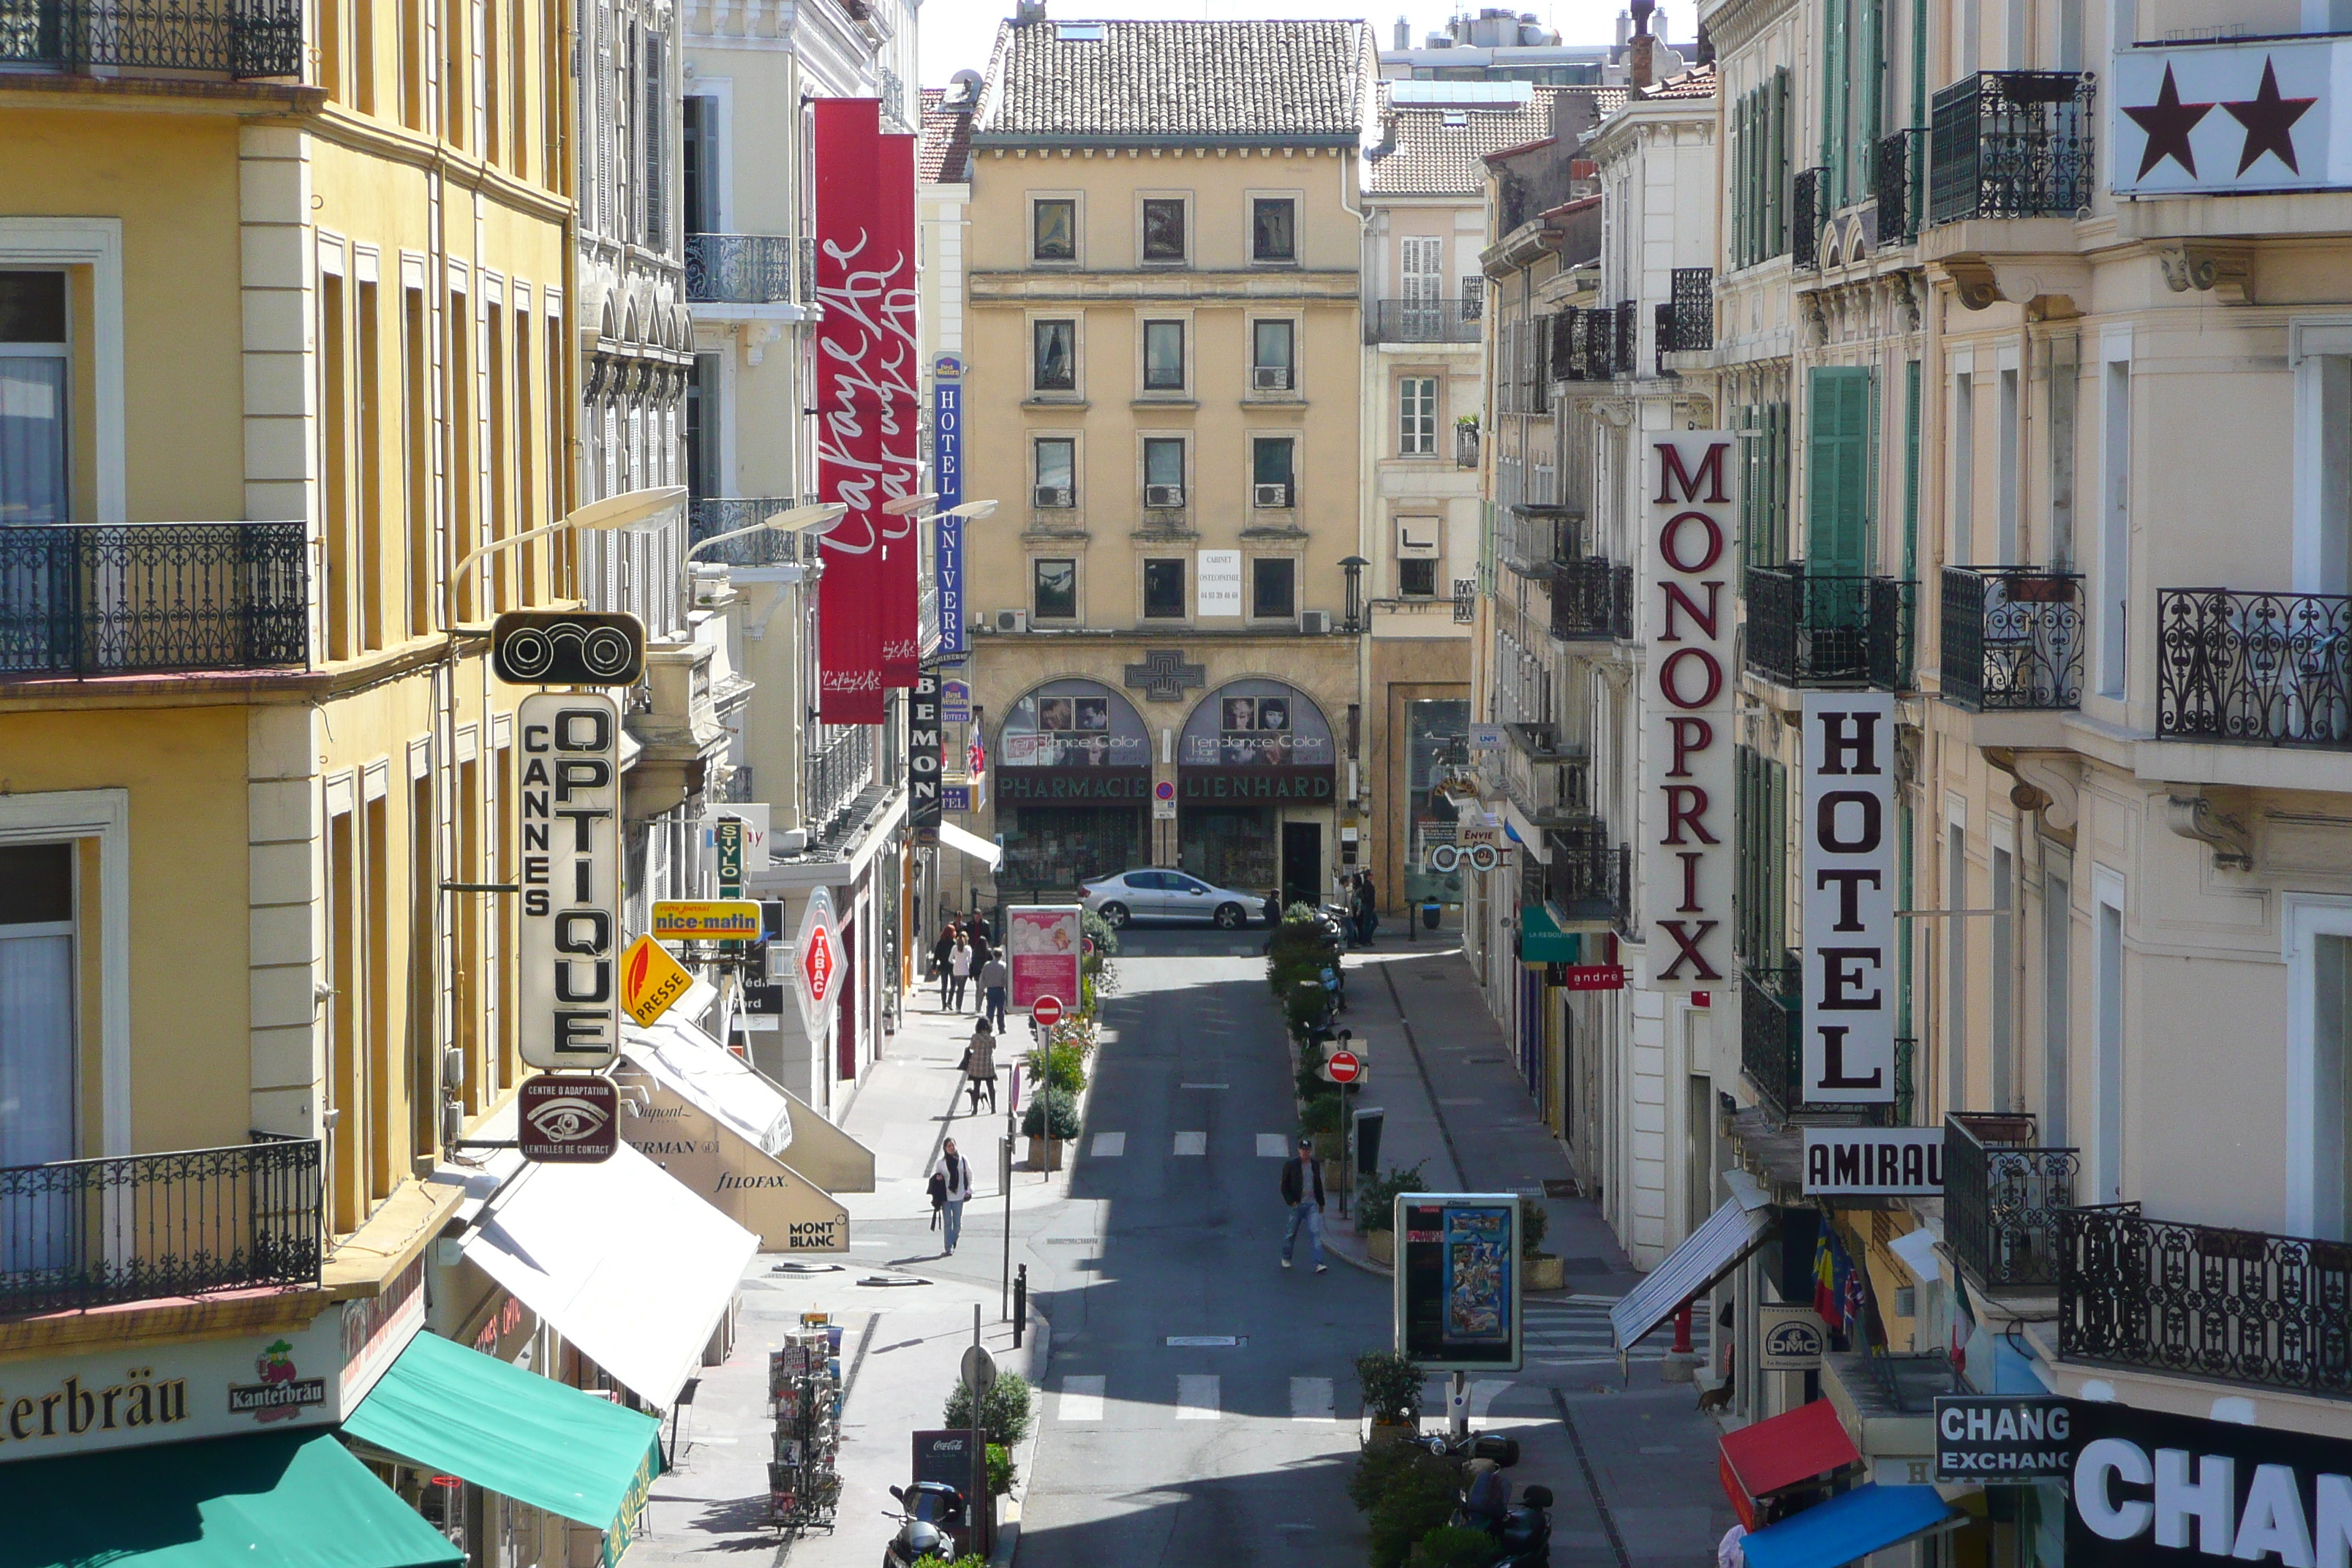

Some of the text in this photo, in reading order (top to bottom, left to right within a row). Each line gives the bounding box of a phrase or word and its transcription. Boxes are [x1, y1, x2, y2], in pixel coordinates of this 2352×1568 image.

[941, 391, 956, 649] HOTEL UNIVERS
[1652, 442, 1730, 980] MONOPRIX
[911, 677, 938, 799] BEMON
[1096, 735, 1142, 747] Color
[1188, 735, 1326, 750] Tendance Color
[1000, 777, 1330, 797] PHARMACIE LIENHARD
[522, 725, 550, 917] CANNES
[1464, 830, 1493, 840] ENVIE
[720, 826, 739, 877] STYLO
[554, 708, 612, 1055] OPTIQUE
[678, 905, 710, 915] journal
[1817, 712, 1882, 1090] HOTEL
[655, 913, 756, 929] nice-matin
[813, 935, 826, 992] TABAC
[636, 972, 684, 1020] PRESSE
[528, 1086, 609, 1096] CENTRE D'ADAPTATION
[628, 1102, 692, 1123] Dupont
[525, 1145, 609, 1154] LENTILLES DE CONTACT
[630, 1140, 697, 1154] ERMAN
[789, 1222, 834, 1235] MONT
[789, 1235, 835, 1248] BLANC
[1770, 1339, 1820, 1352] DMC
[0, 1368, 191, 1443] erbräu
[232, 1383, 323, 1409] Kanterbräu
[1940, 1407, 2070, 1441] CHANG
[933, 1439, 964, 1451] Coca-Cola
